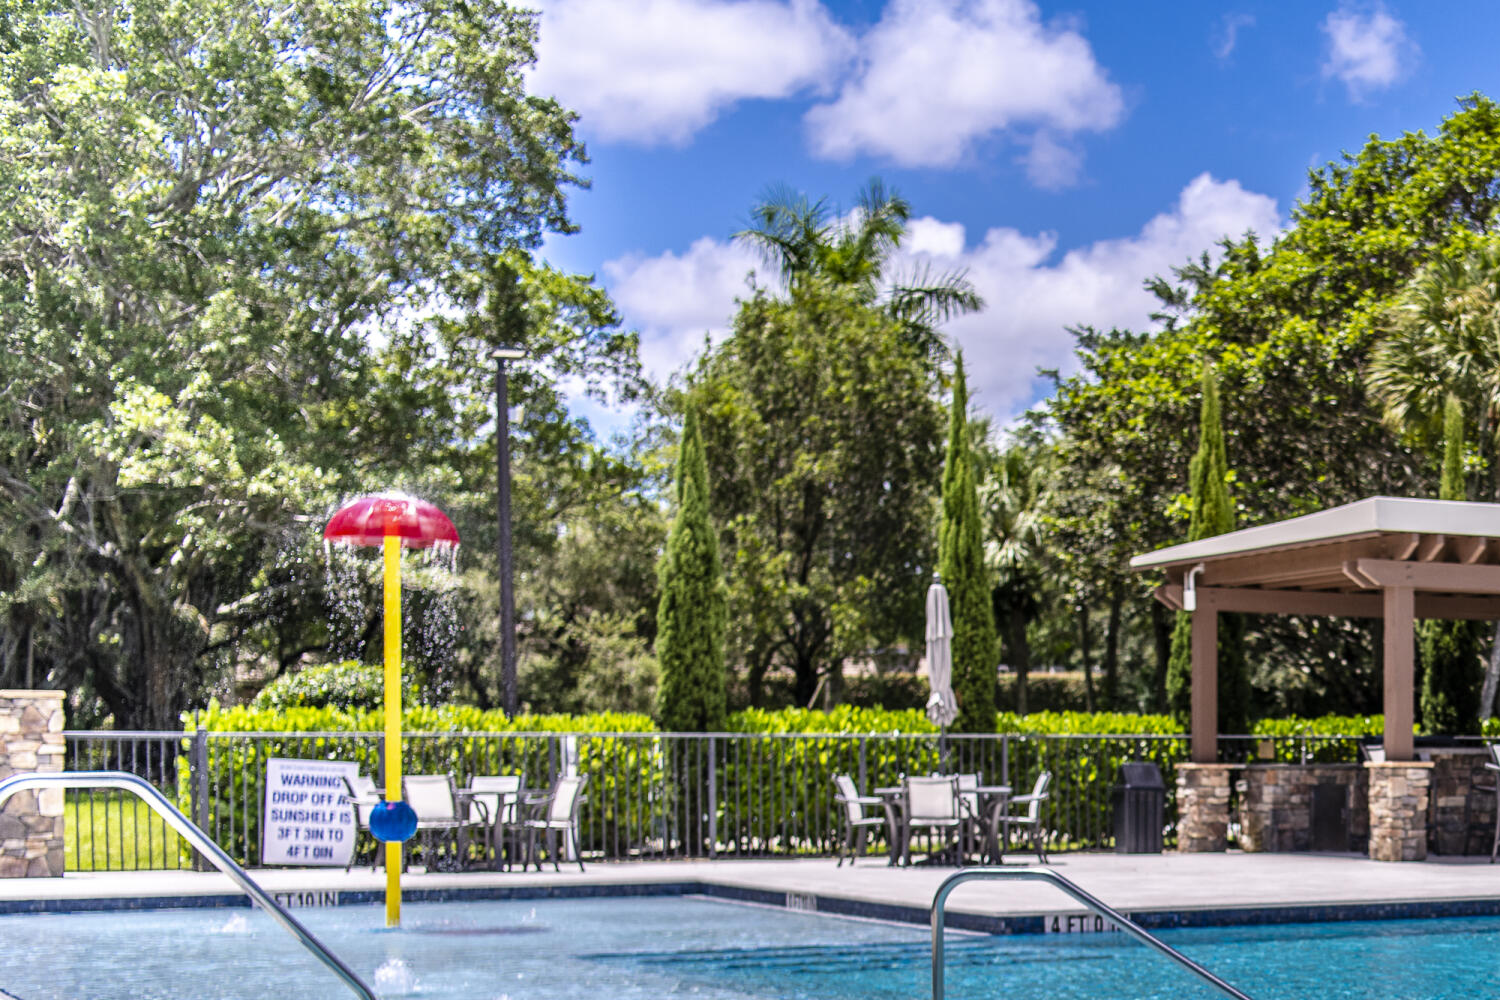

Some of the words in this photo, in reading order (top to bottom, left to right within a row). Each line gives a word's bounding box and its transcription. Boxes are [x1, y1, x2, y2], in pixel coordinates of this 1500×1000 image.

[281, 773, 341, 788] WARNING
[272, 791, 308, 804] DROP
[311, 792, 334, 805] OFF
[271, 809, 334, 823] SUNSHELF
[340, 811, 351, 824] IS
[328, 828, 344, 841] TO
[286, 845, 309, 858] 4FT
[319, 891, 335, 907] IN
[1068, 914, 1087, 933] FT
